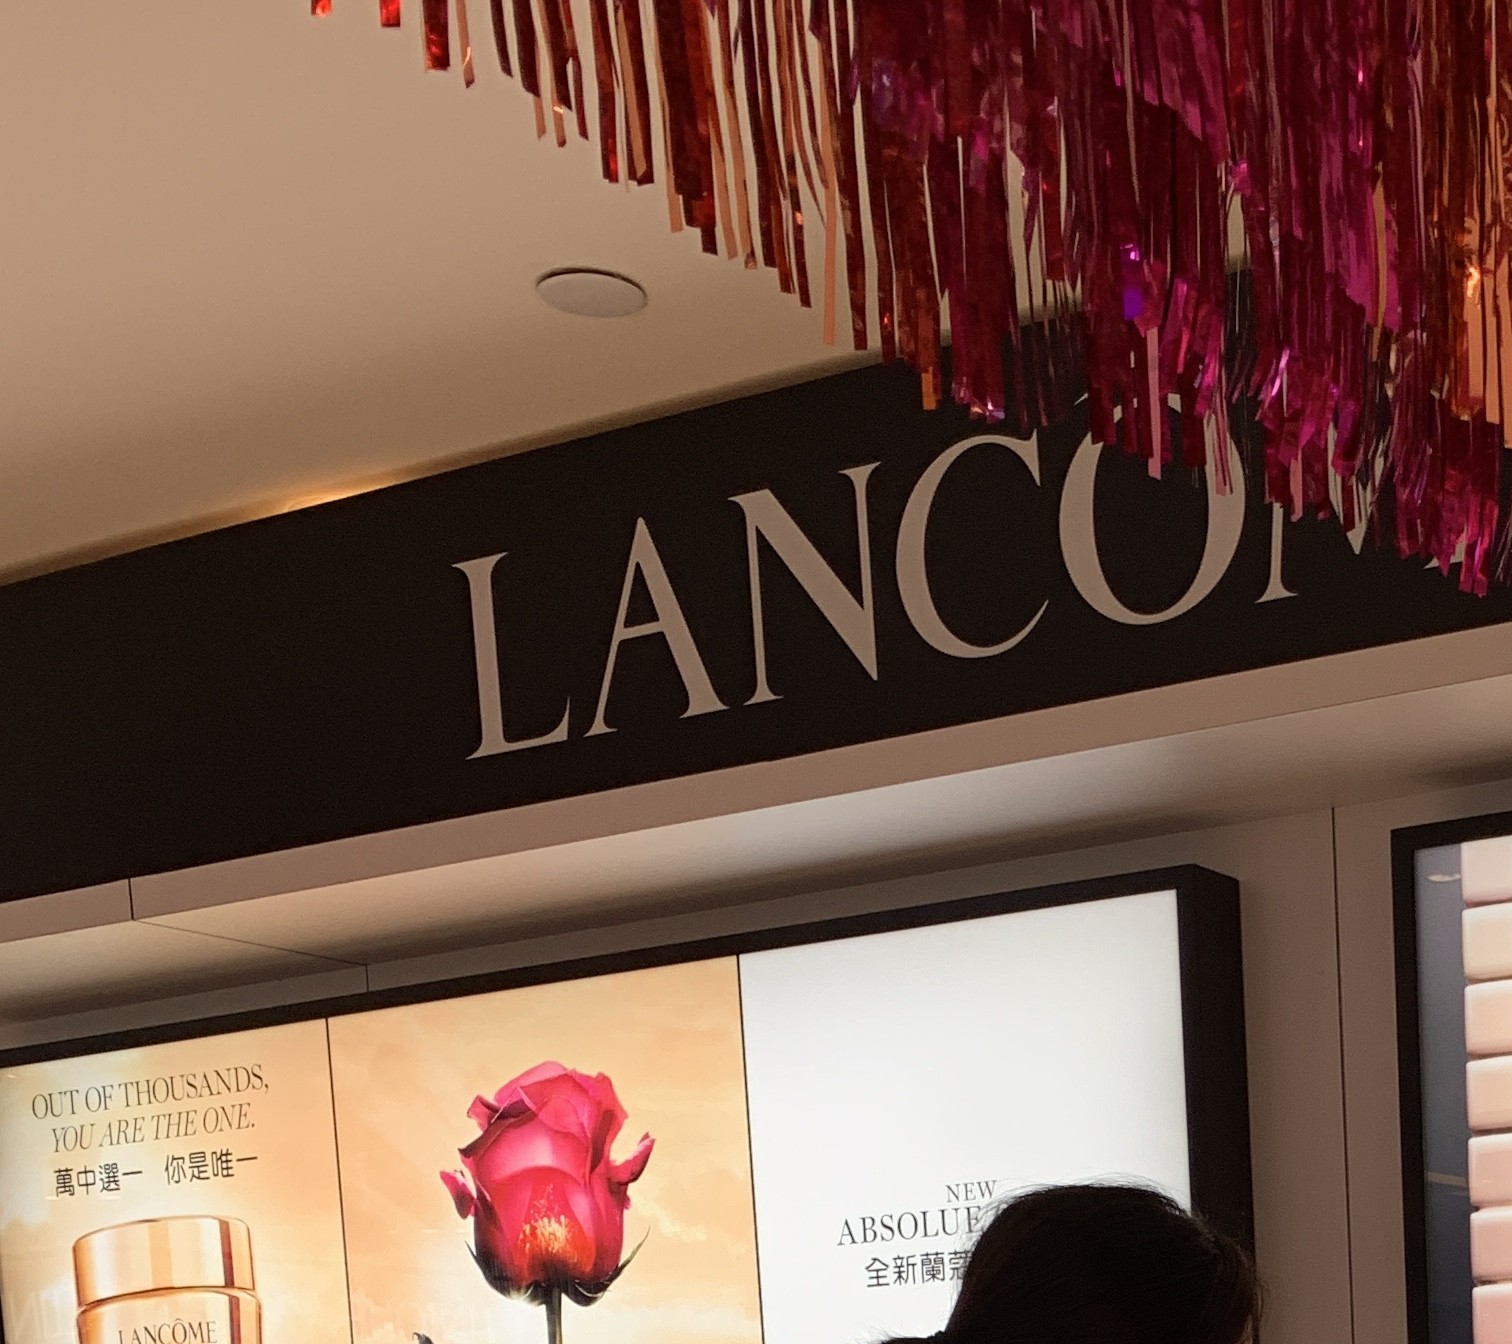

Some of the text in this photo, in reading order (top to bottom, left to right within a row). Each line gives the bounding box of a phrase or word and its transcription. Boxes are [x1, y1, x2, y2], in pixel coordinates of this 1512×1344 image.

[32, 1063, 269, 1119] OUT OF THOUSANDS,
[51, 1103, 255, 1153] YOU ARE THE ONE.
[54, 1148, 258, 1198] 萬中選一 你是唯一
[946, 1180, 996, 1203] NEW
[837, 1205, 985, 1246] ABSOLUE
